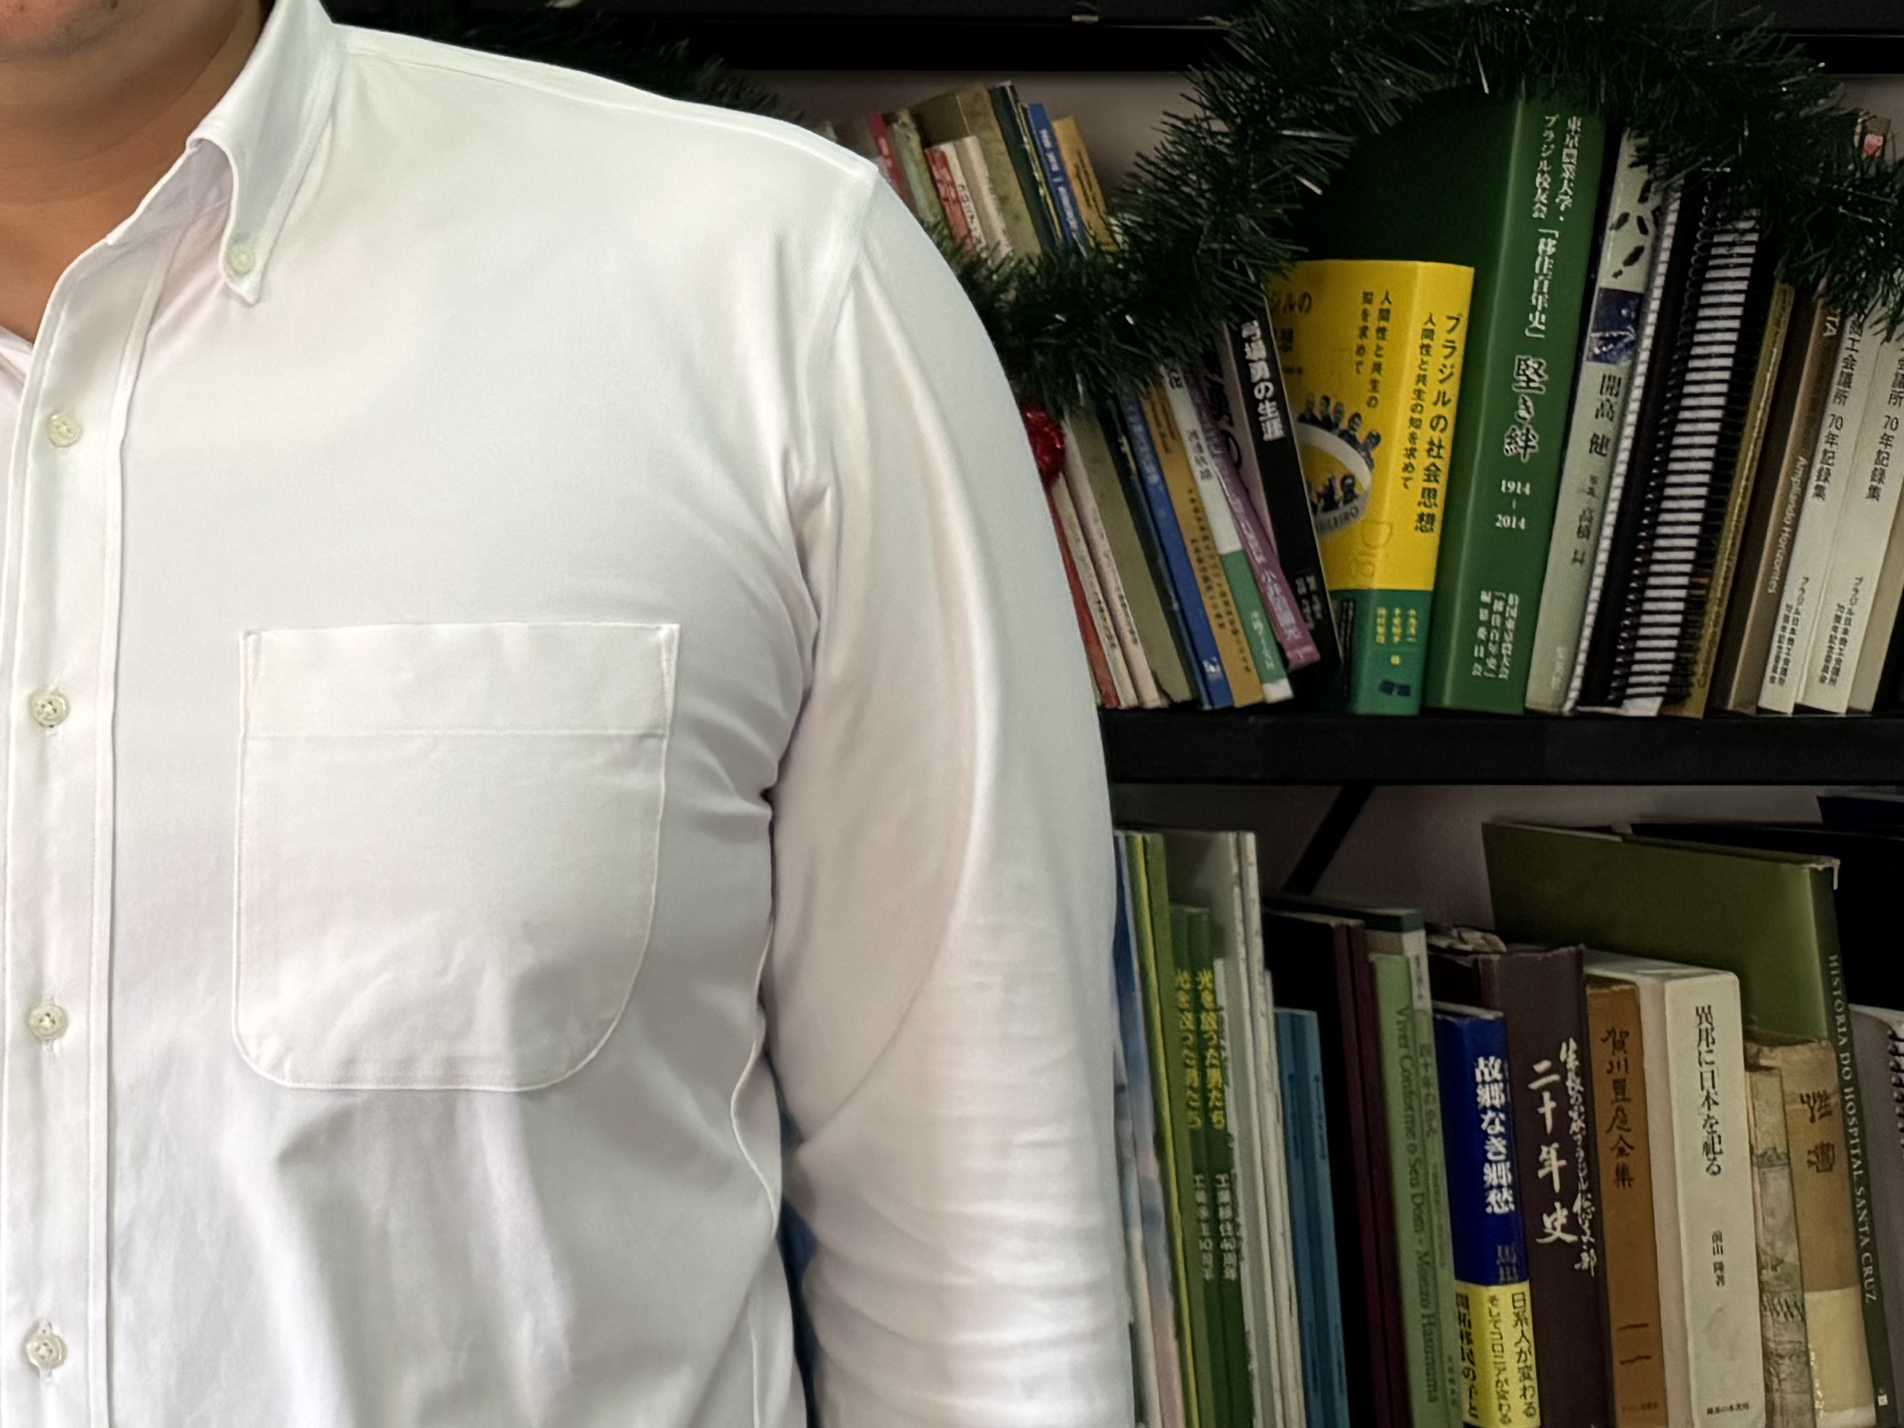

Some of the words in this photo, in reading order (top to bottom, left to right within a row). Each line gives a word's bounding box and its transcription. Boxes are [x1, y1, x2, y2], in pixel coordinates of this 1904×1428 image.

[1400, 311, 1438, 490] 人間性と共生の知を求めて
[1414, 311, 1463, 534] ブラジルの社会思想
[1503, 355, 1549, 462] 堅き絆
[1495, 514, 1527, 530] 2014
[1500, 479, 1532, 496] 1914
[1474, 1055, 1515, 1215] 故郷なき郷愁
[1527, 1059, 1578, 1244] 二十年史
